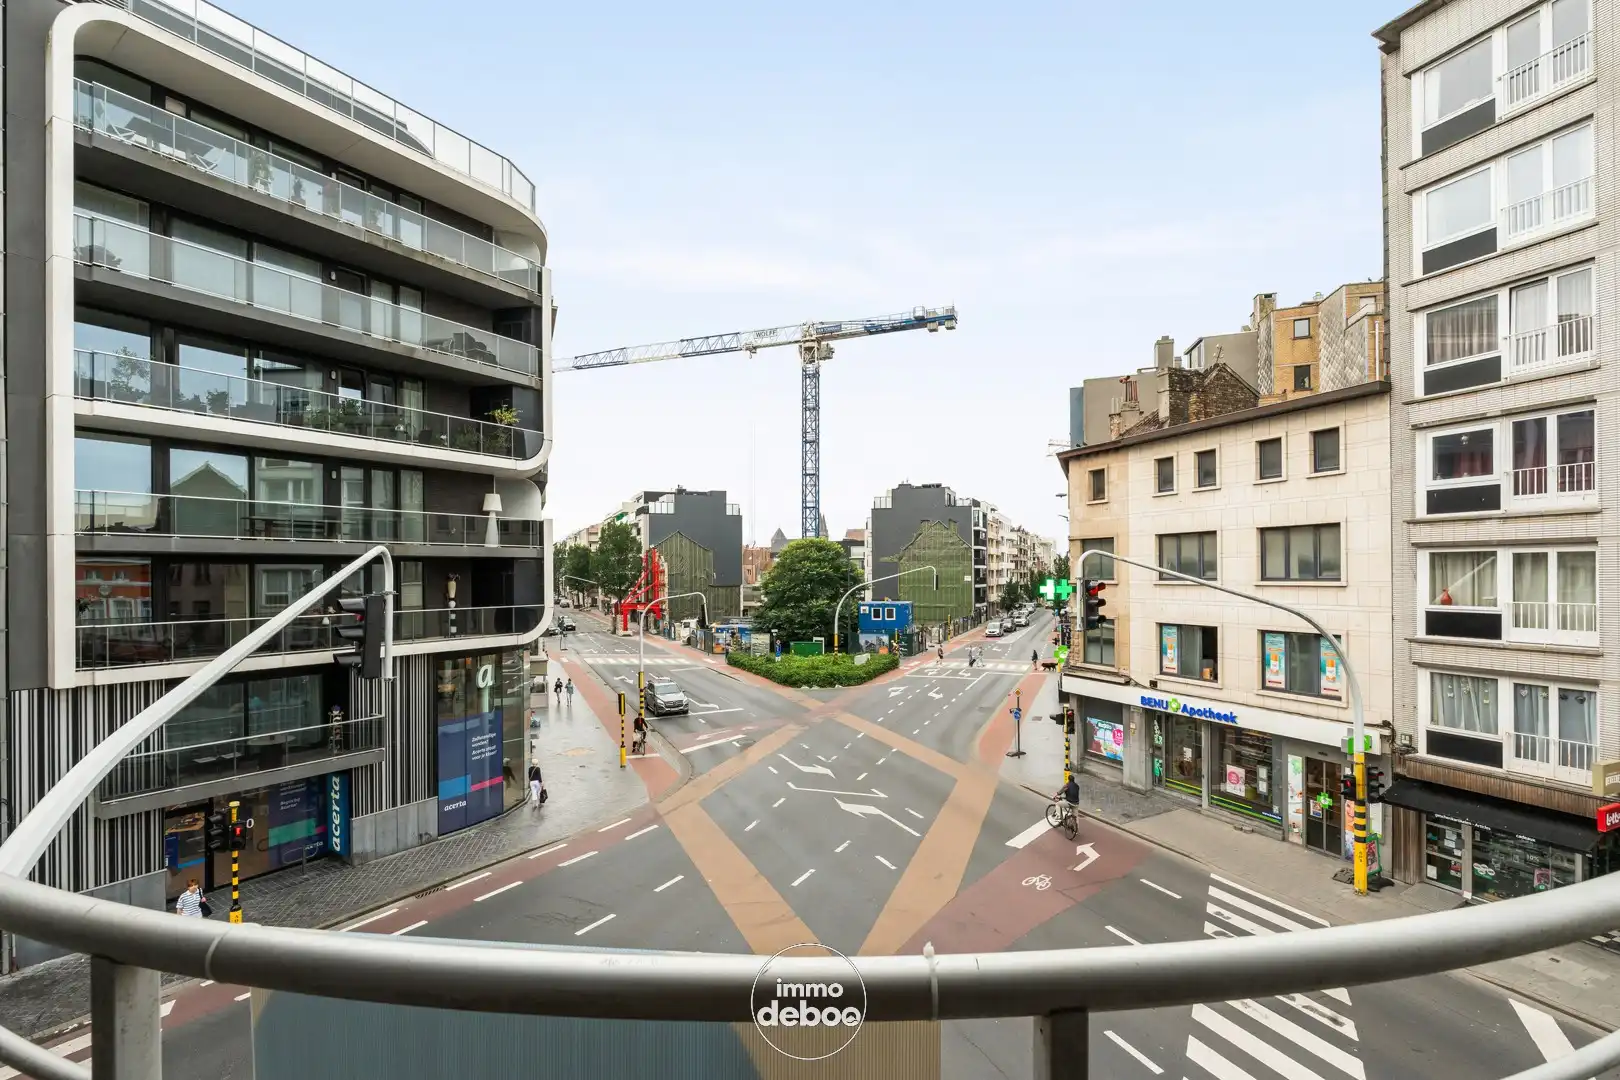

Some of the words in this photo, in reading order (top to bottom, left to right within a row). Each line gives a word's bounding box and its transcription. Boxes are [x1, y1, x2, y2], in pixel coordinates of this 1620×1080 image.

[755, 329, 777, 337] WOLFF
[1140, 696, 1168, 710] BENU
[1181, 704, 1238, 724] Apotheek
[331, 775, 340, 851] acerta
[444, 800, 467, 811] acerta
